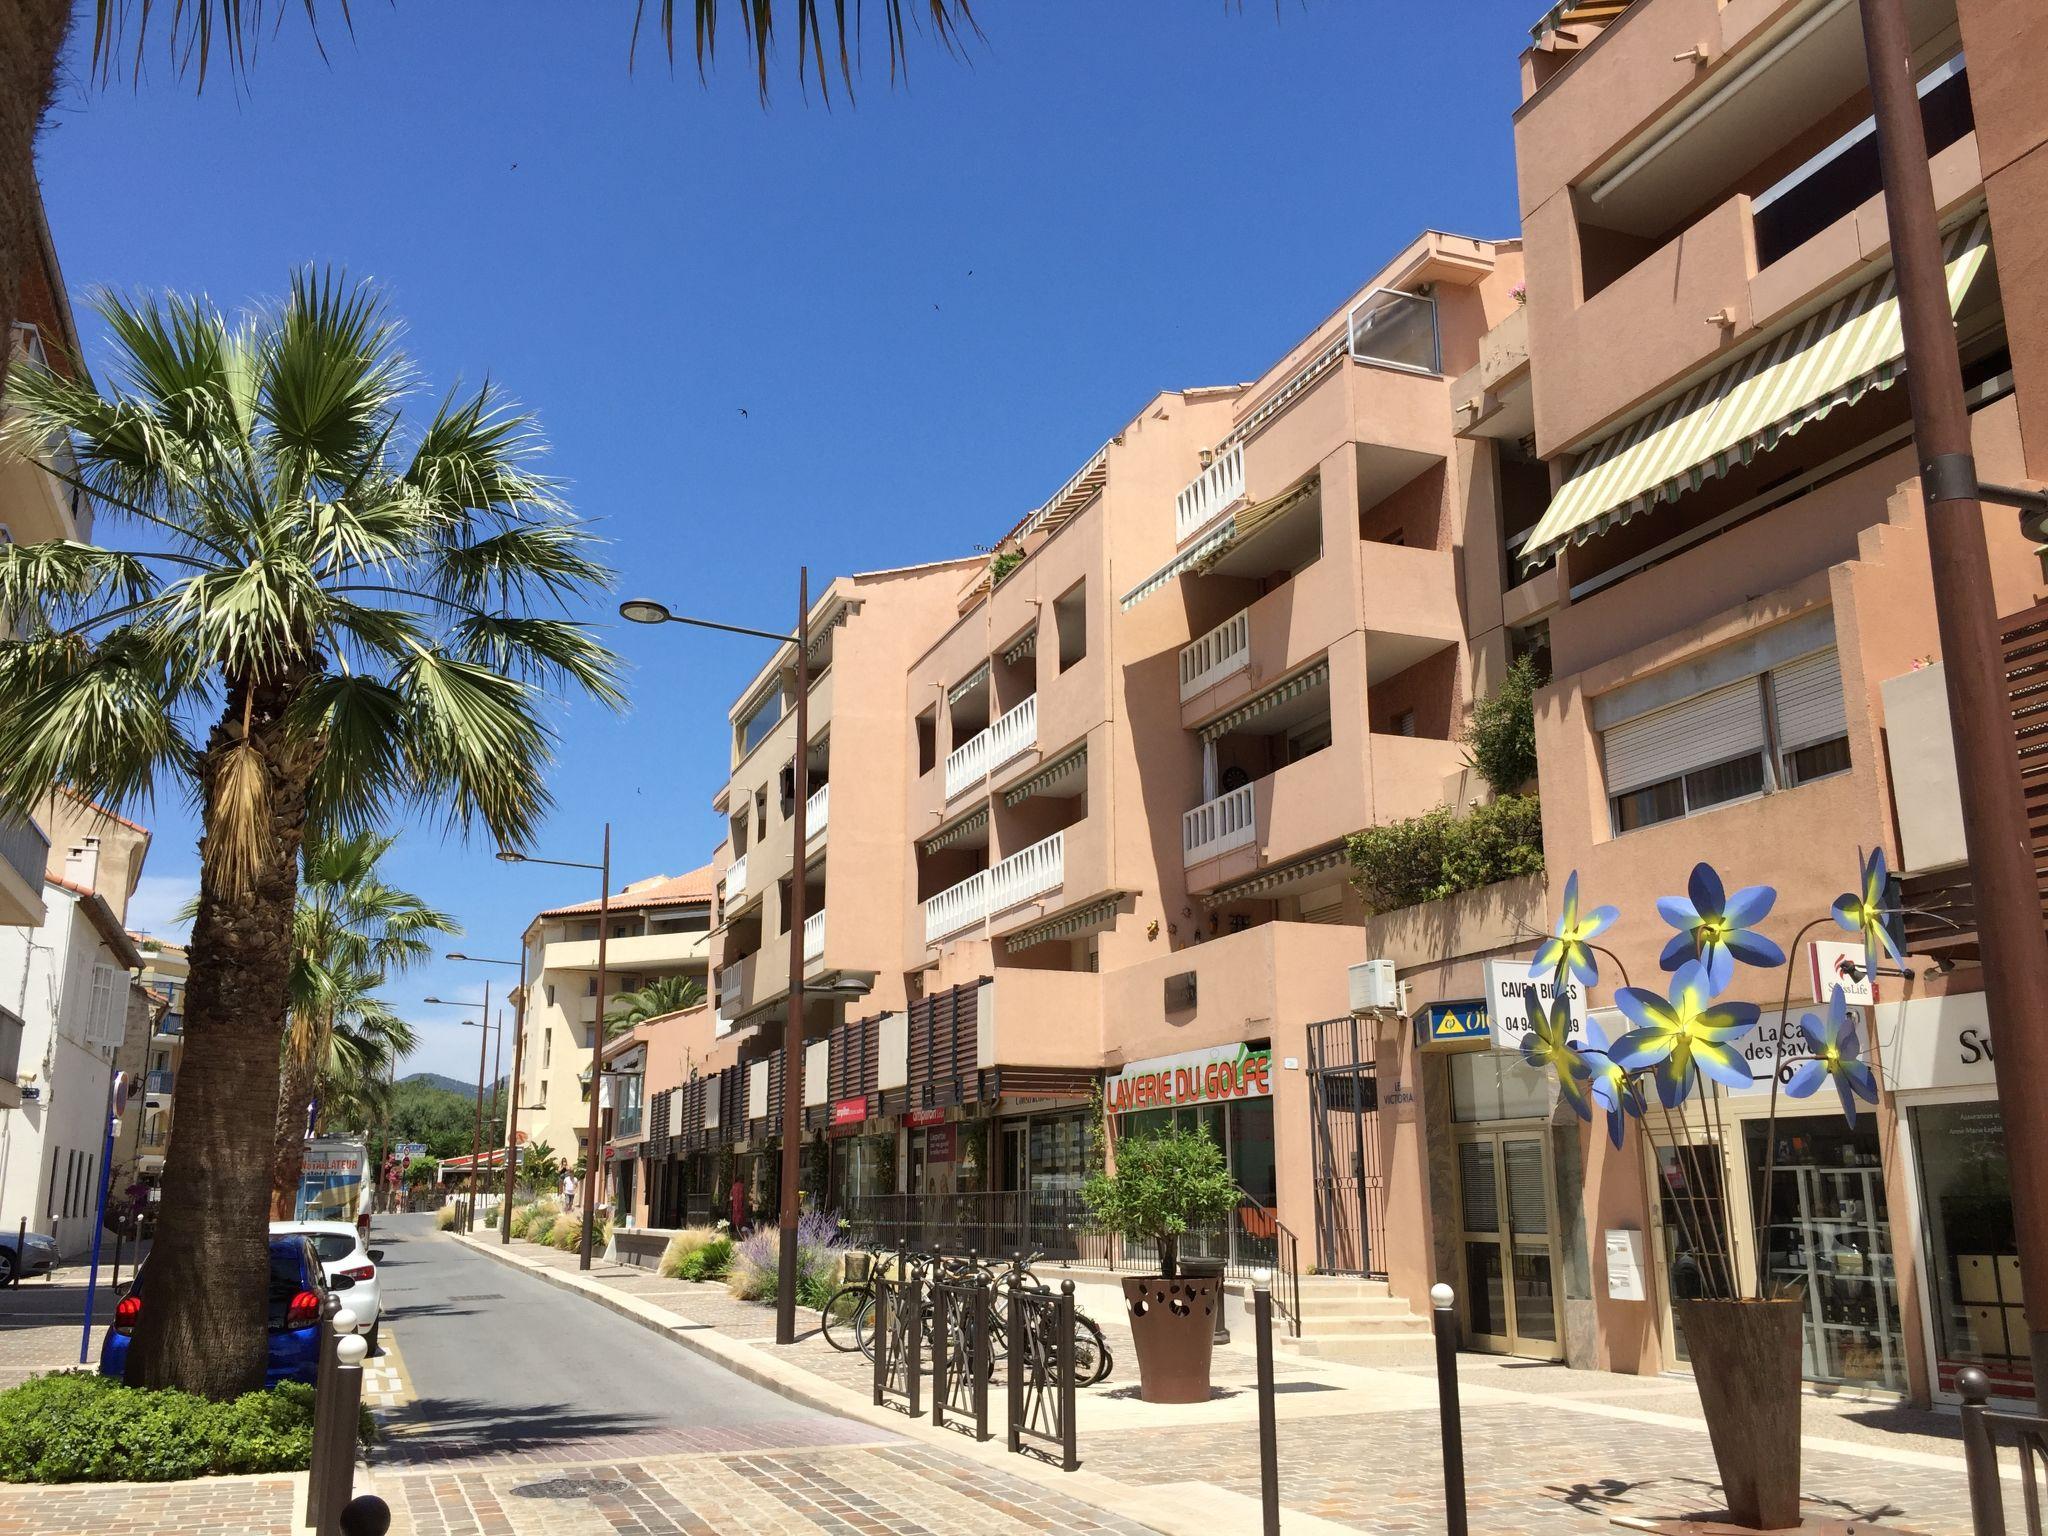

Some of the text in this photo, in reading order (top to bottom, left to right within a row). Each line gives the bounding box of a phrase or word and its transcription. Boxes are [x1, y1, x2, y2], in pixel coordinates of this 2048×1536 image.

[1501, 981, 1528, 998] CAVE
[1505, 1016, 1519, 1031] 04
[1758, 1022, 1806, 1042] La Ca
[1744, 1042, 1773, 1061] des
[1106, 1056, 1269, 1113] LAVERIE DU GOLFE
[1383, 1092, 1414, 1104] VICTORIA
